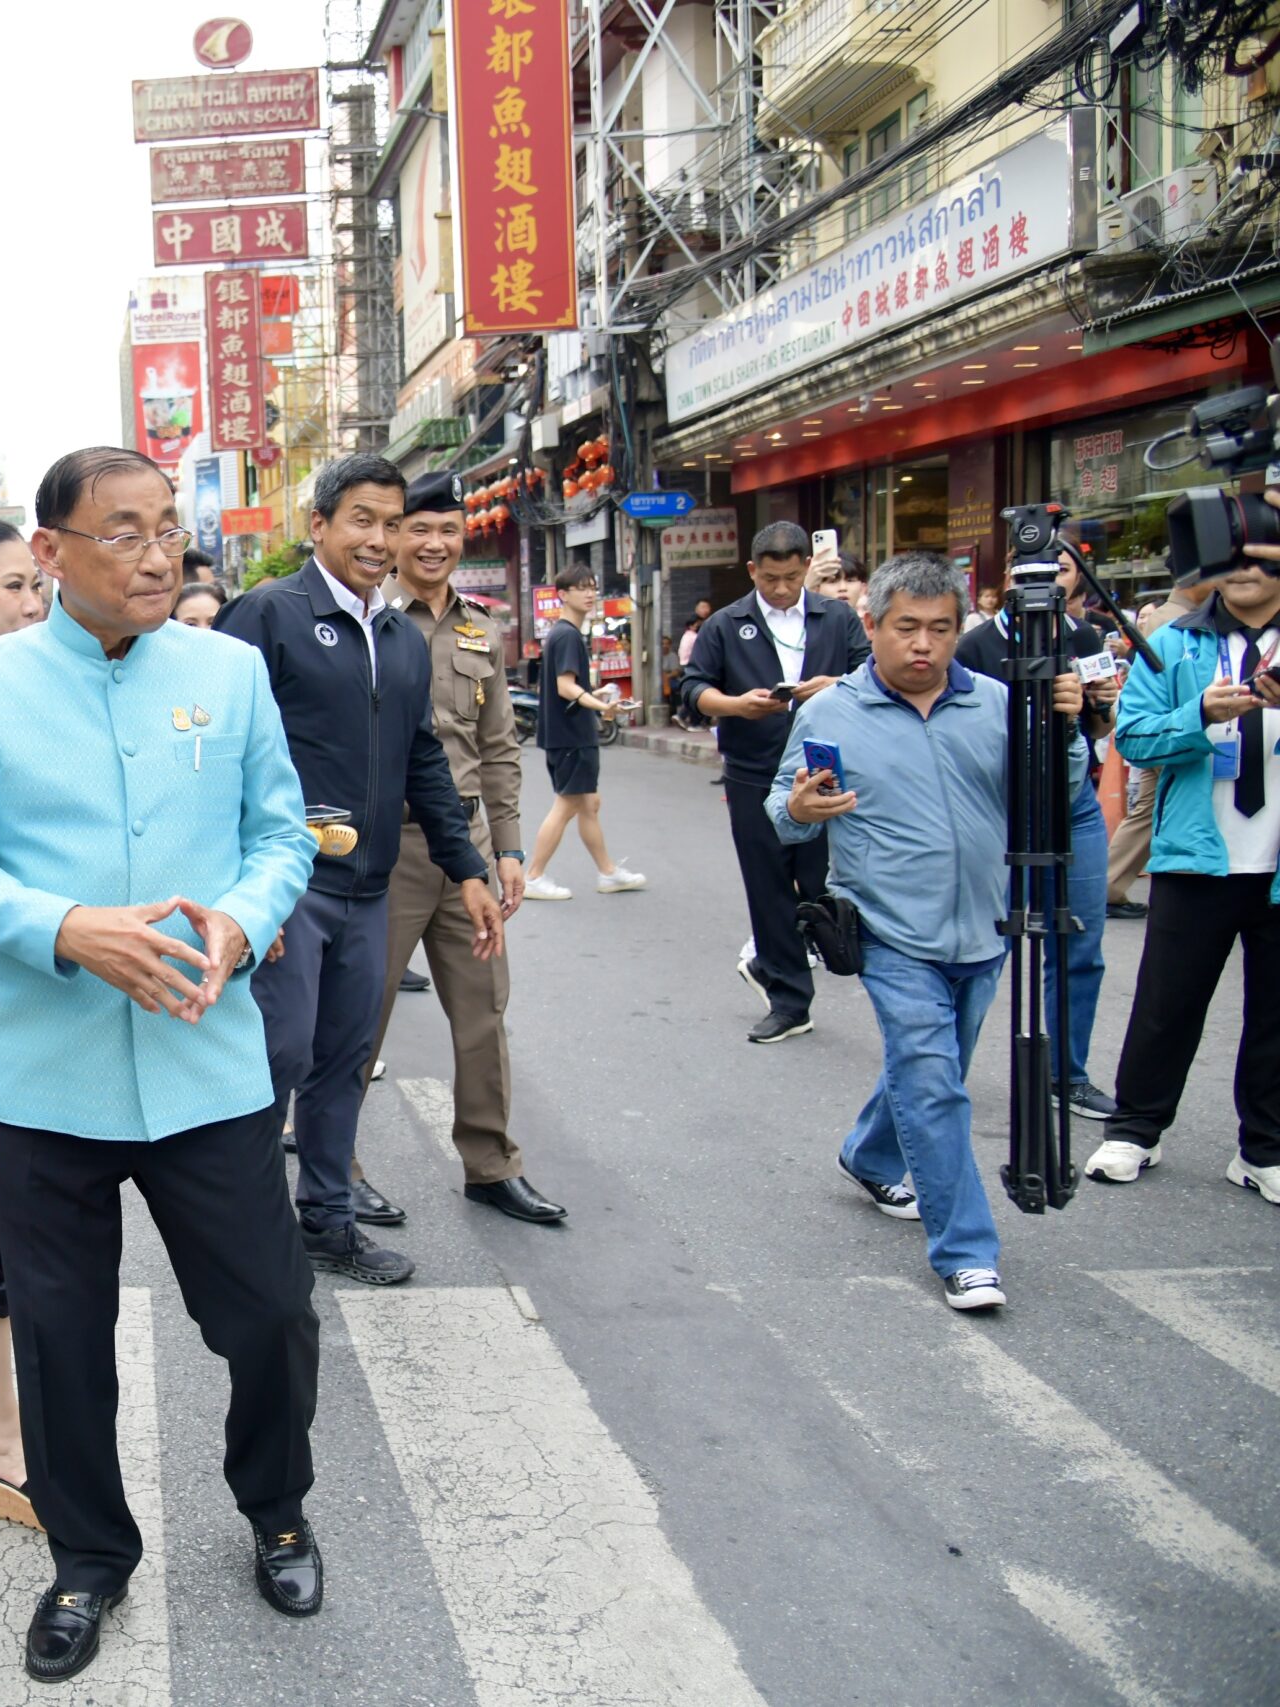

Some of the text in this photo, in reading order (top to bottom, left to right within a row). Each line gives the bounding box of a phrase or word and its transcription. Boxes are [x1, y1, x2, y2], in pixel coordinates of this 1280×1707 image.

[145, 105, 309, 132] CHINA TOWN SCALA
[162, 209, 293, 261] 中國城
[215, 278, 256, 443] 銀都魚翅酒樓
[780, 321, 837, 363] RESTAURANT
[1078, 464, 1118, 498] 魚翅
[676, 496, 686, 510] 2
